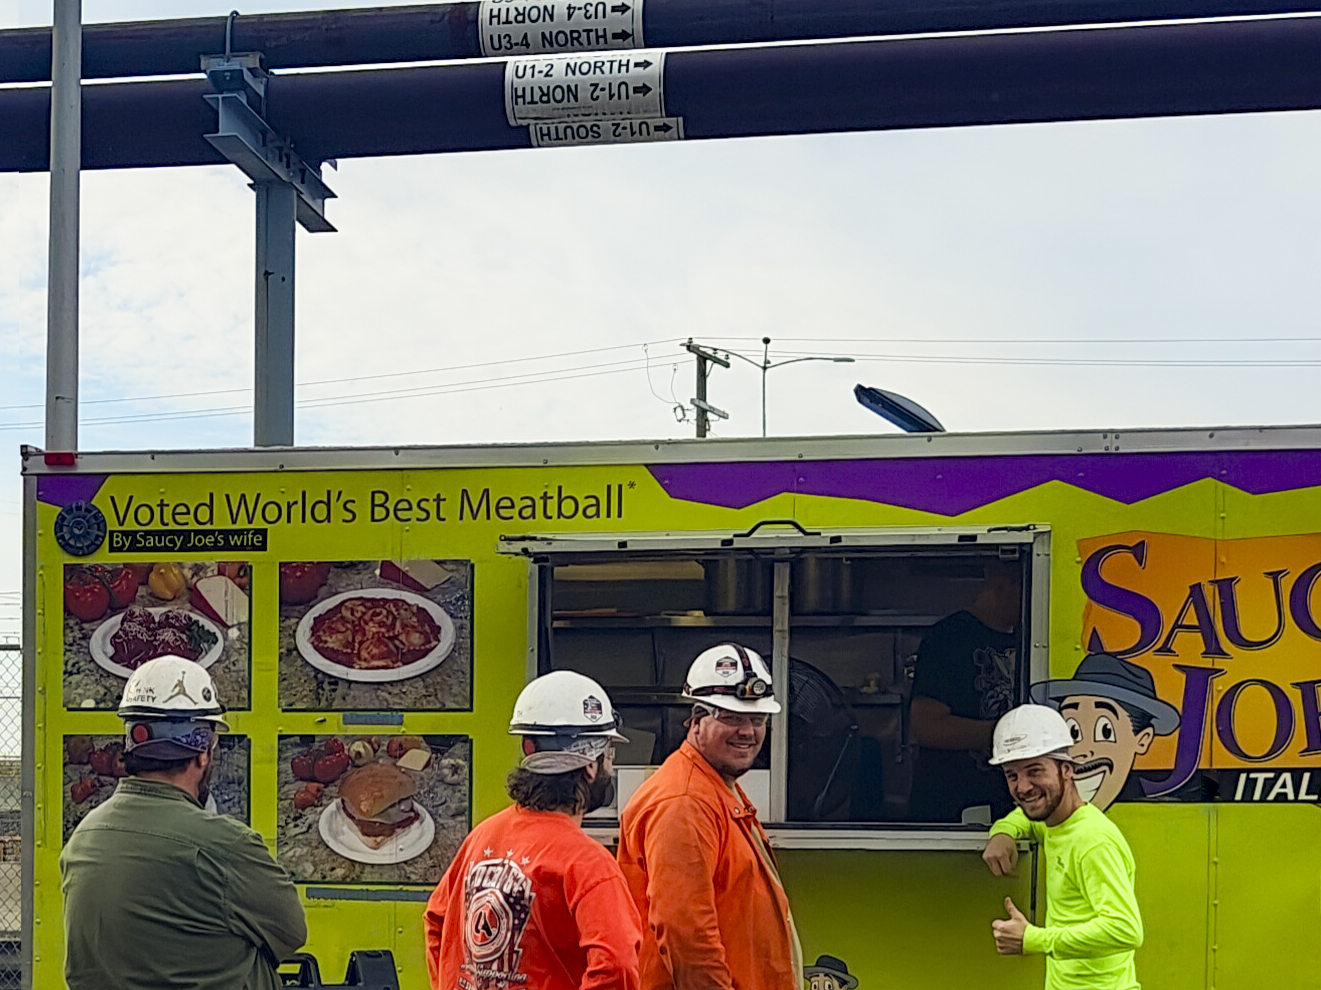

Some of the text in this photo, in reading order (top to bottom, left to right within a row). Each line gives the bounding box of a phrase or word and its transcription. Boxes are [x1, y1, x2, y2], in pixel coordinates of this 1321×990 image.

[489, 2, 606, 26] U3-4 NORTH
[489, 28, 608, 51] U3-4 NORTH
[515, 59, 631, 79] U1-2 NORTH
[514, 81, 629, 106] U1-2 NORTH
[539, 121, 651, 142] U1-2 SOUTH
[109, 492, 214, 527] Voted
[225, 490, 357, 525] World's
[370, 490, 447, 523] Best
[113, 530, 262, 550] By Saucy Joe's wife
[1234, 772, 1320, 801] ITAL
